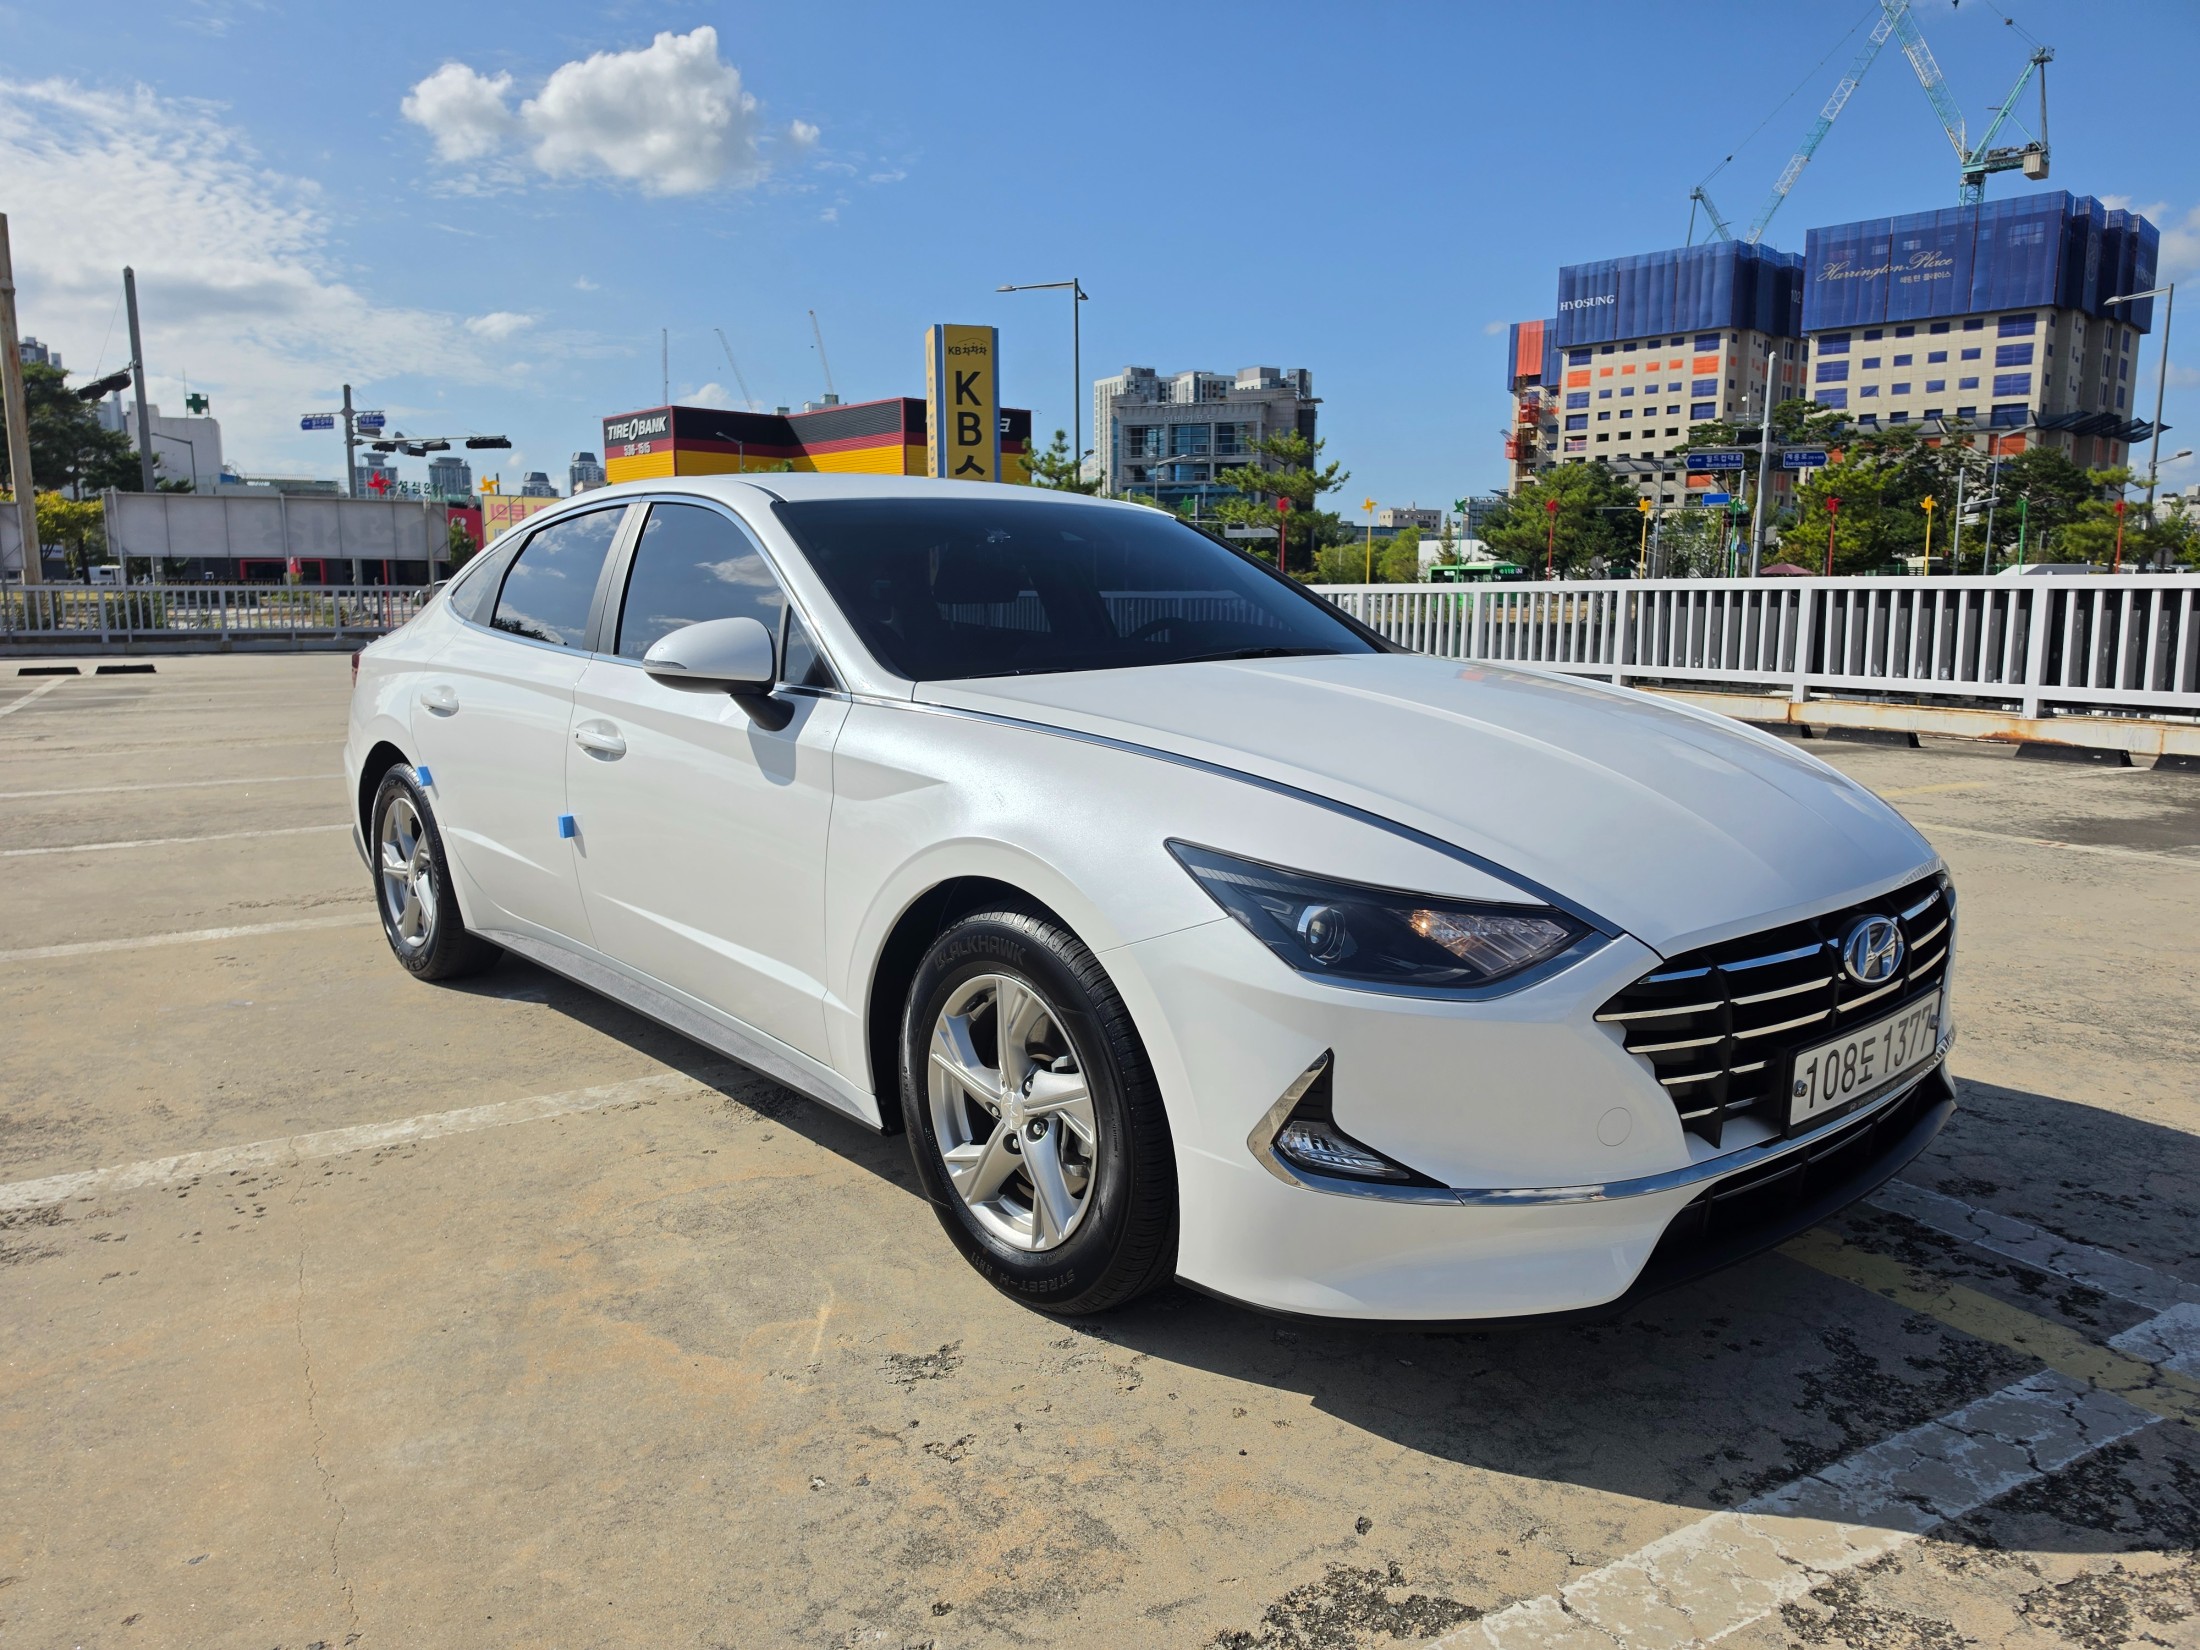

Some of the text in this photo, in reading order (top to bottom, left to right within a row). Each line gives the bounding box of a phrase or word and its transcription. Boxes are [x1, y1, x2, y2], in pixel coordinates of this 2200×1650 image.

[1816, 250, 1953, 282] Harrington Place
[1559, 294, 1616, 311] HYOSUNG
[1706, 454, 1741, 463] 월드컵대로
[935, 935, 1026, 971] BLACKHAWK
[1883, 1002, 1933, 1074] 1377
